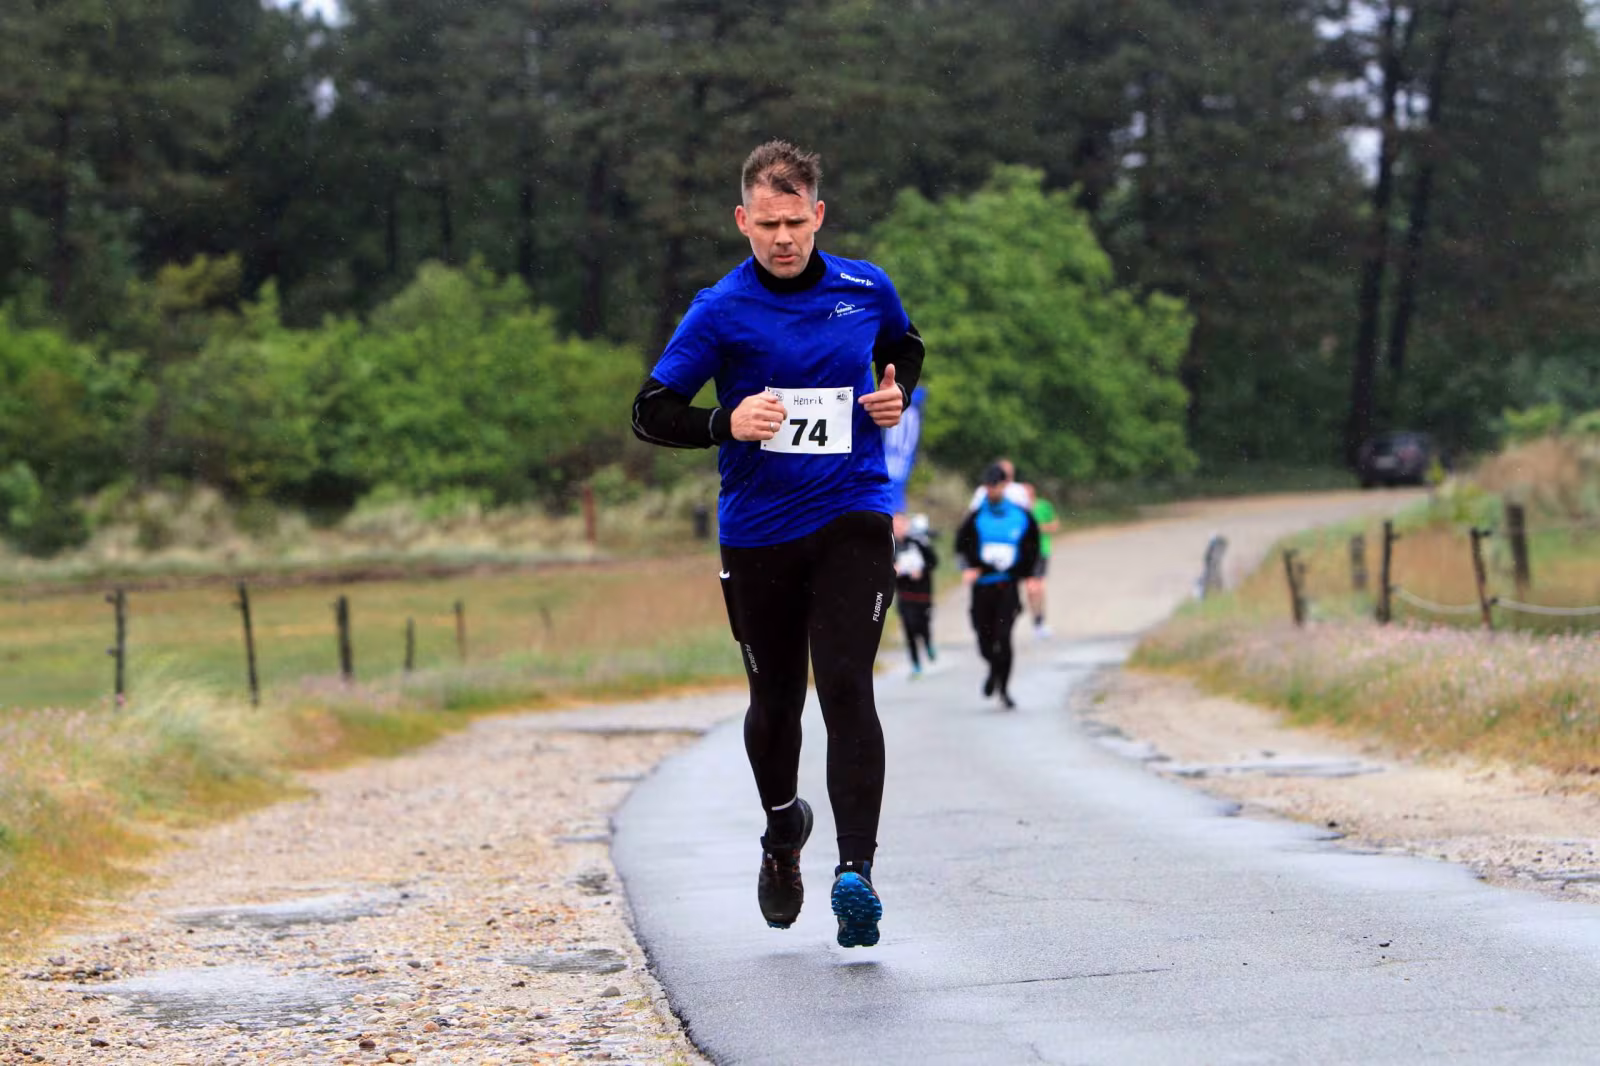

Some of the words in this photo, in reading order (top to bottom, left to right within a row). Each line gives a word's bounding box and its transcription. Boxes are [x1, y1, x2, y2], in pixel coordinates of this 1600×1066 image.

[793, 395, 823, 405] Henrik
[789, 418, 828, 447] 74
[872, 591, 884, 622] FUSION
[744, 643, 759, 674] FUSION
